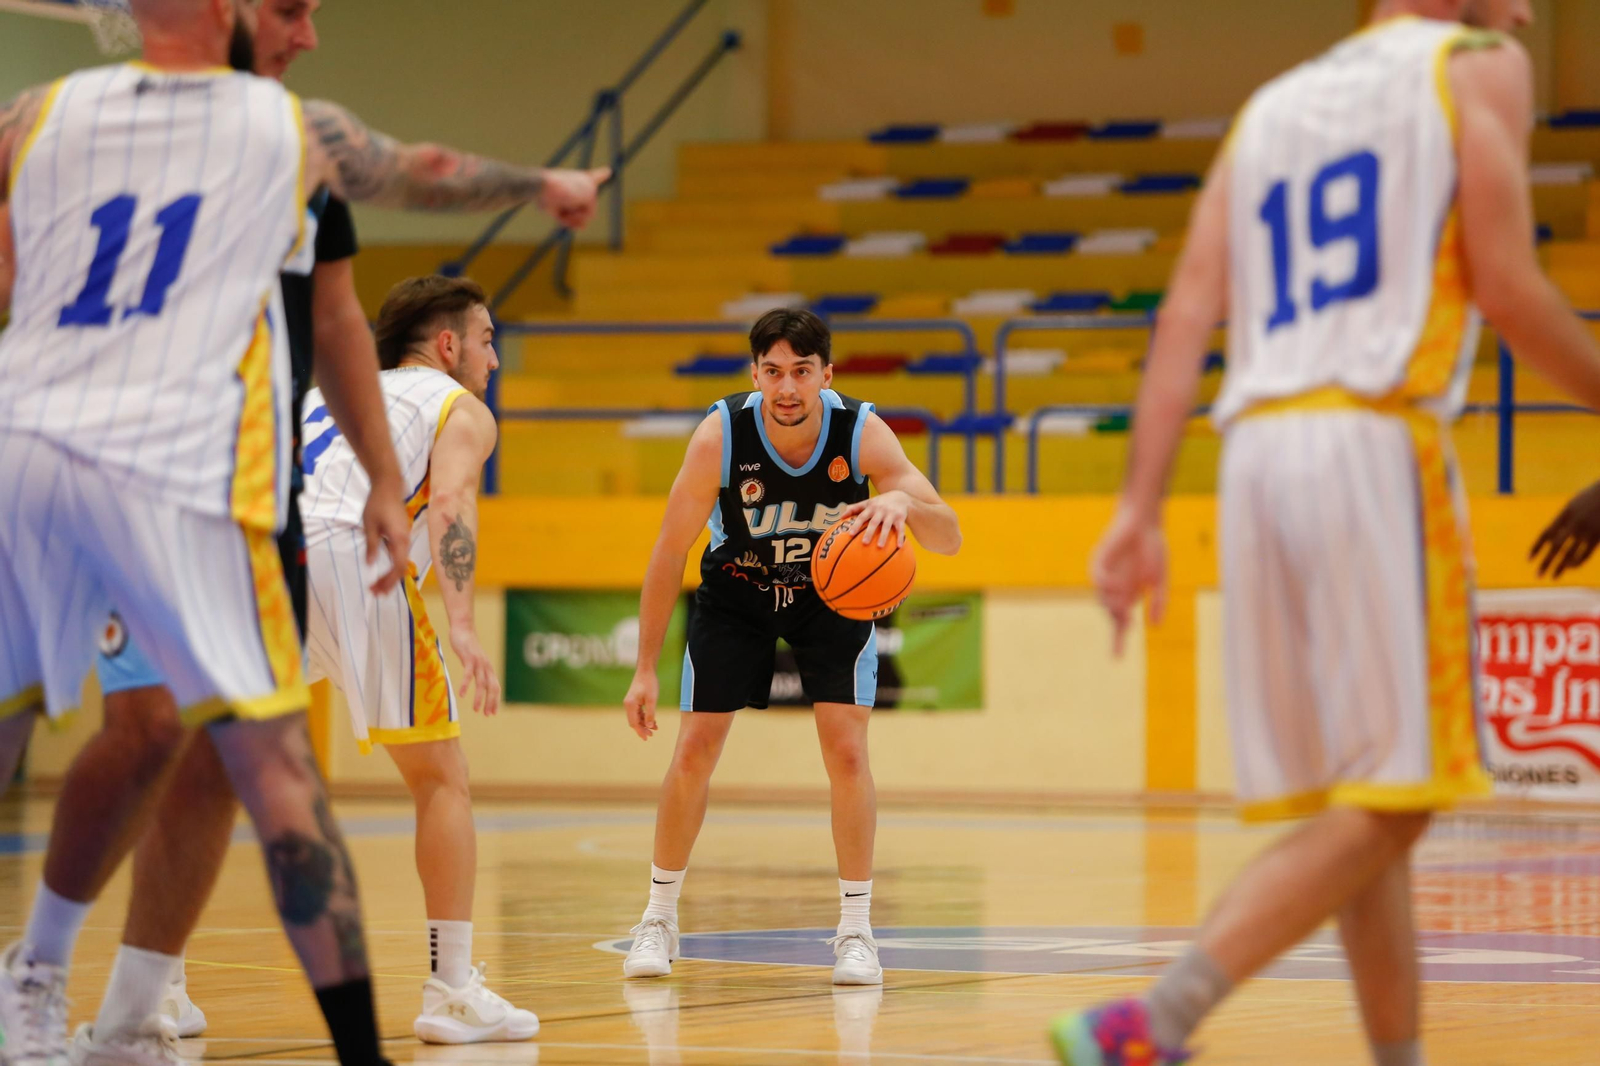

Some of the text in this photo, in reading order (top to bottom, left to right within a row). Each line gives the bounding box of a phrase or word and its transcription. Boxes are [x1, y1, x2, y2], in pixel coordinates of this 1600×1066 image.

[57, 193, 203, 327] 11
[1259, 150, 1379, 332] 19
[739, 462, 761, 472] vive
[742, 501, 848, 539] ULE
[771, 537, 811, 564] 12
